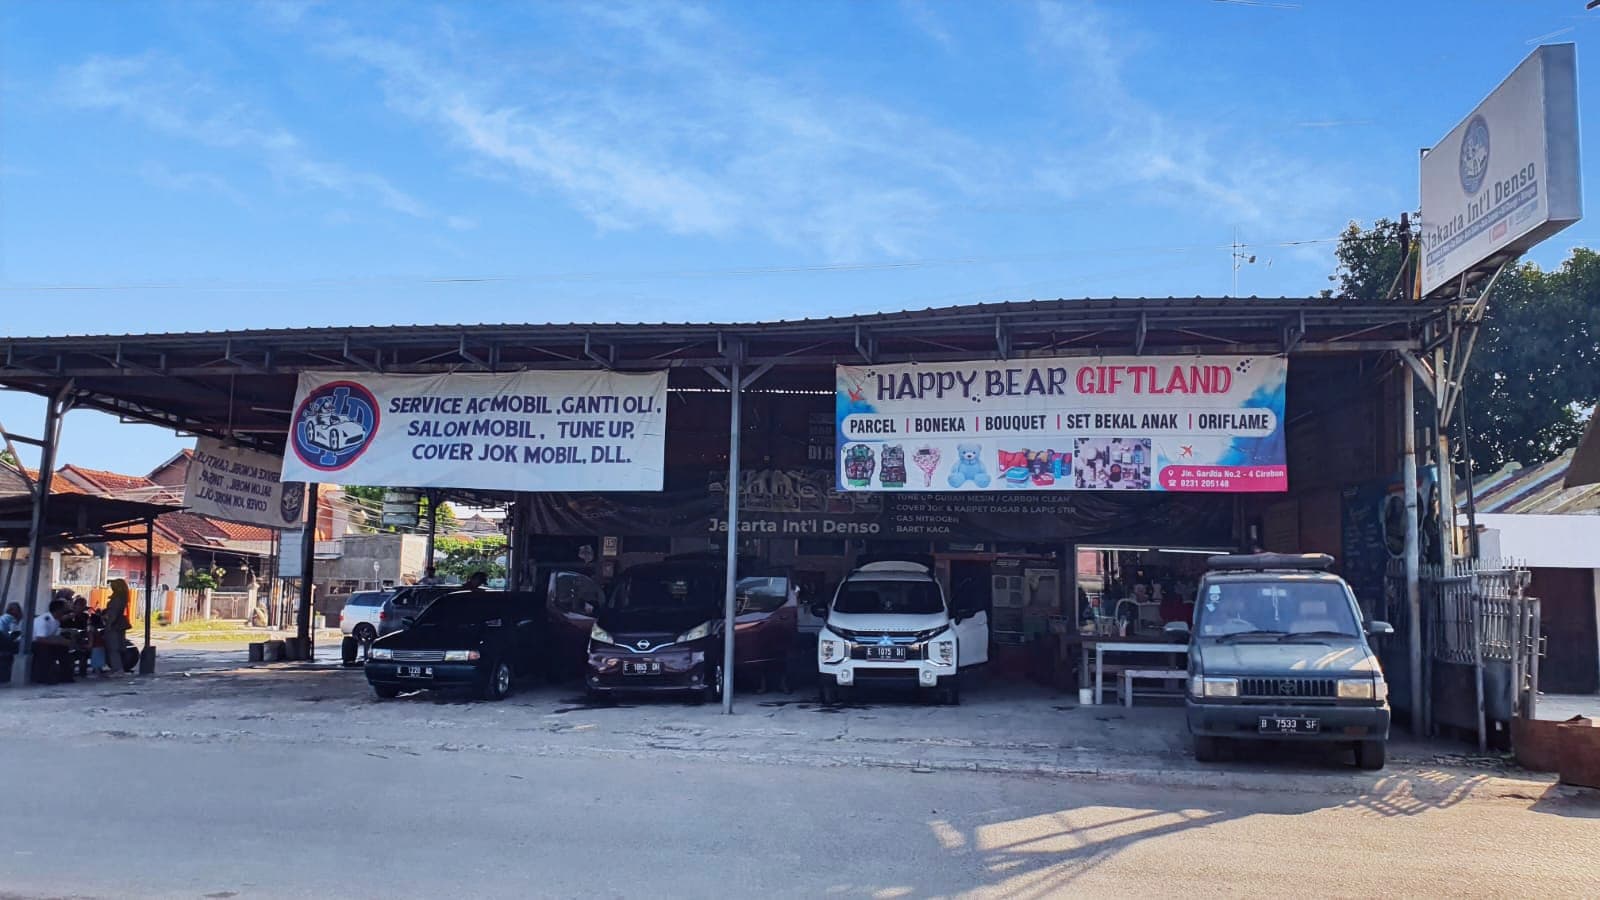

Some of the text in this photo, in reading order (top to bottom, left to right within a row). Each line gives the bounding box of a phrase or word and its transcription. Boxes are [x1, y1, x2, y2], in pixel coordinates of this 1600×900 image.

[1427, 213, 1464, 252] Jakarta
[1467, 187, 1491, 225] Int'l
[1494, 162, 1536, 201] Denso
[877, 365, 1232, 401] HAPPY BEAR GIFTLAND
[389, 396, 463, 414] SERVICE
[558, 421, 605, 439] TUNE
[850, 418, 897, 434] PARCEL
[915, 417, 966, 432] BONEKA
[985, 414, 1047, 432] BOUQUET
[1067, 414, 1091, 430] SET
[1095, 414, 1137, 429] BEKAL
[1141, 414, 1178, 429] ANAK
[1198, 414, 1269, 430] ORIFLAME
[412, 443, 473, 460] COVER
[478, 444, 518, 463] JOK
[783, 519, 817, 533] Int'l
[823, 520, 880, 534] Denso
[1276, 719, 1297, 728] 7533
[1306, 720, 1317, 729] SF
